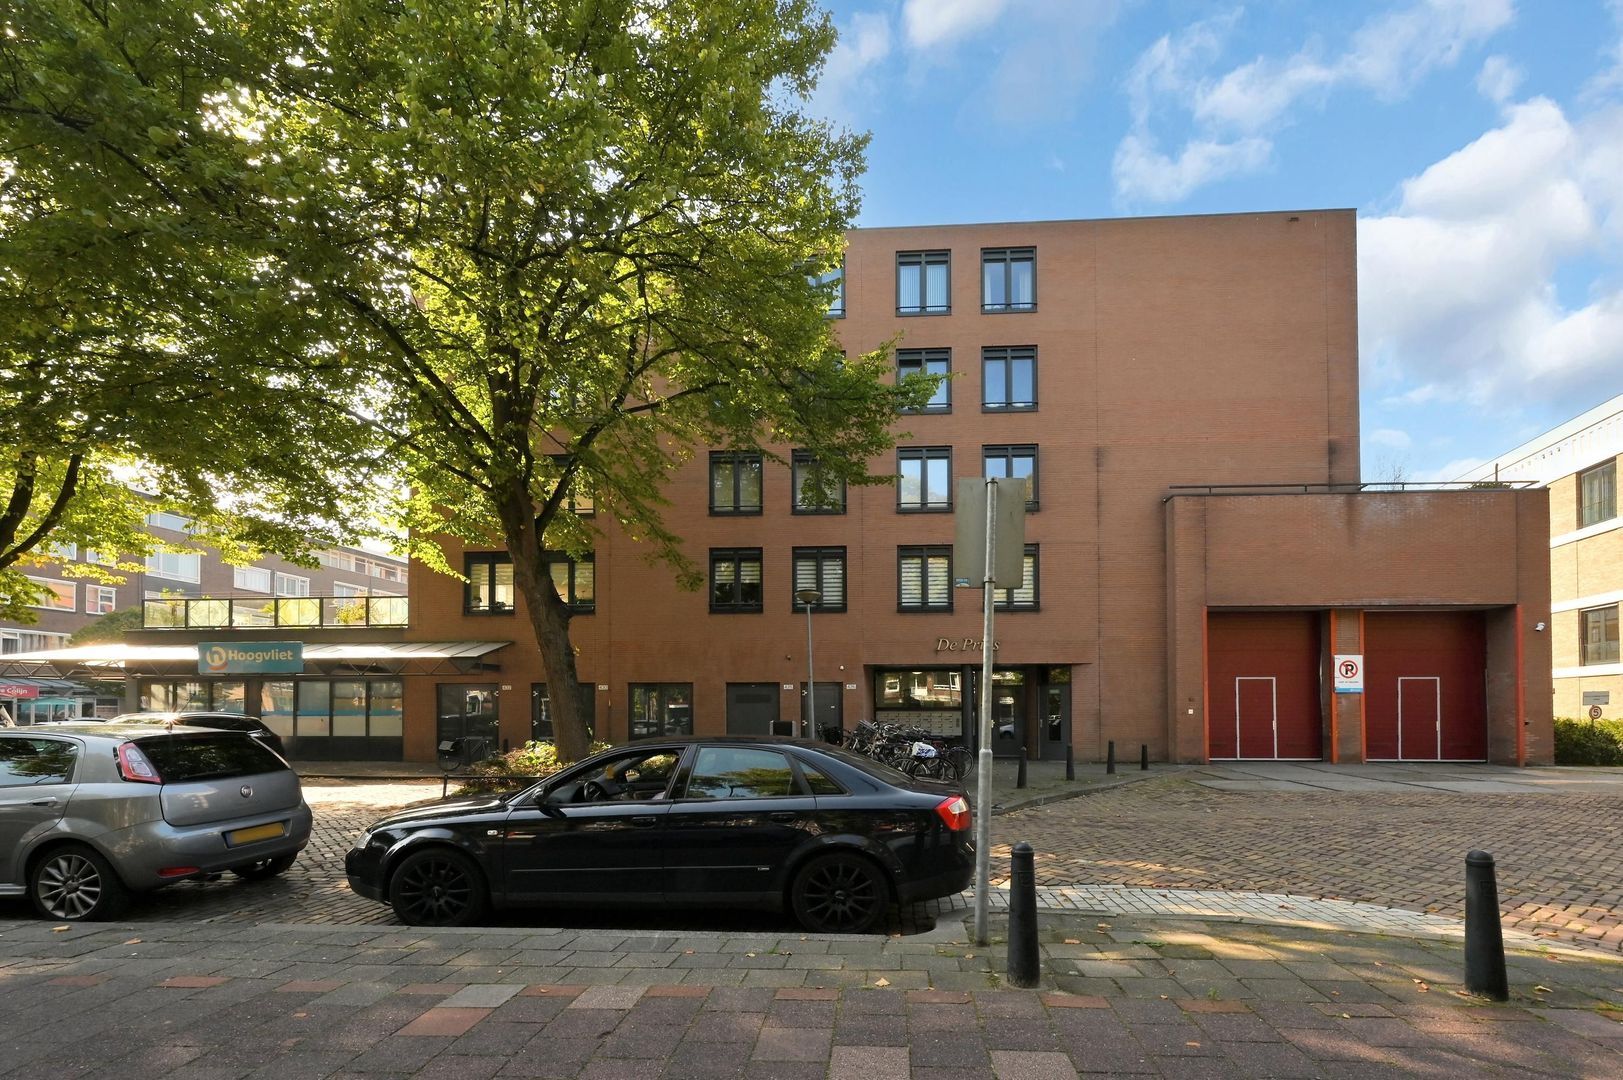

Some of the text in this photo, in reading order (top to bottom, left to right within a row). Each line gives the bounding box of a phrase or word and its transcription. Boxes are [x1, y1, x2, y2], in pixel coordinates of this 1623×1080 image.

[936, 638, 1001, 651] De Pris
[228, 649, 293, 663] Hoogvliet
[1593, 708, 1599, 717] 5
